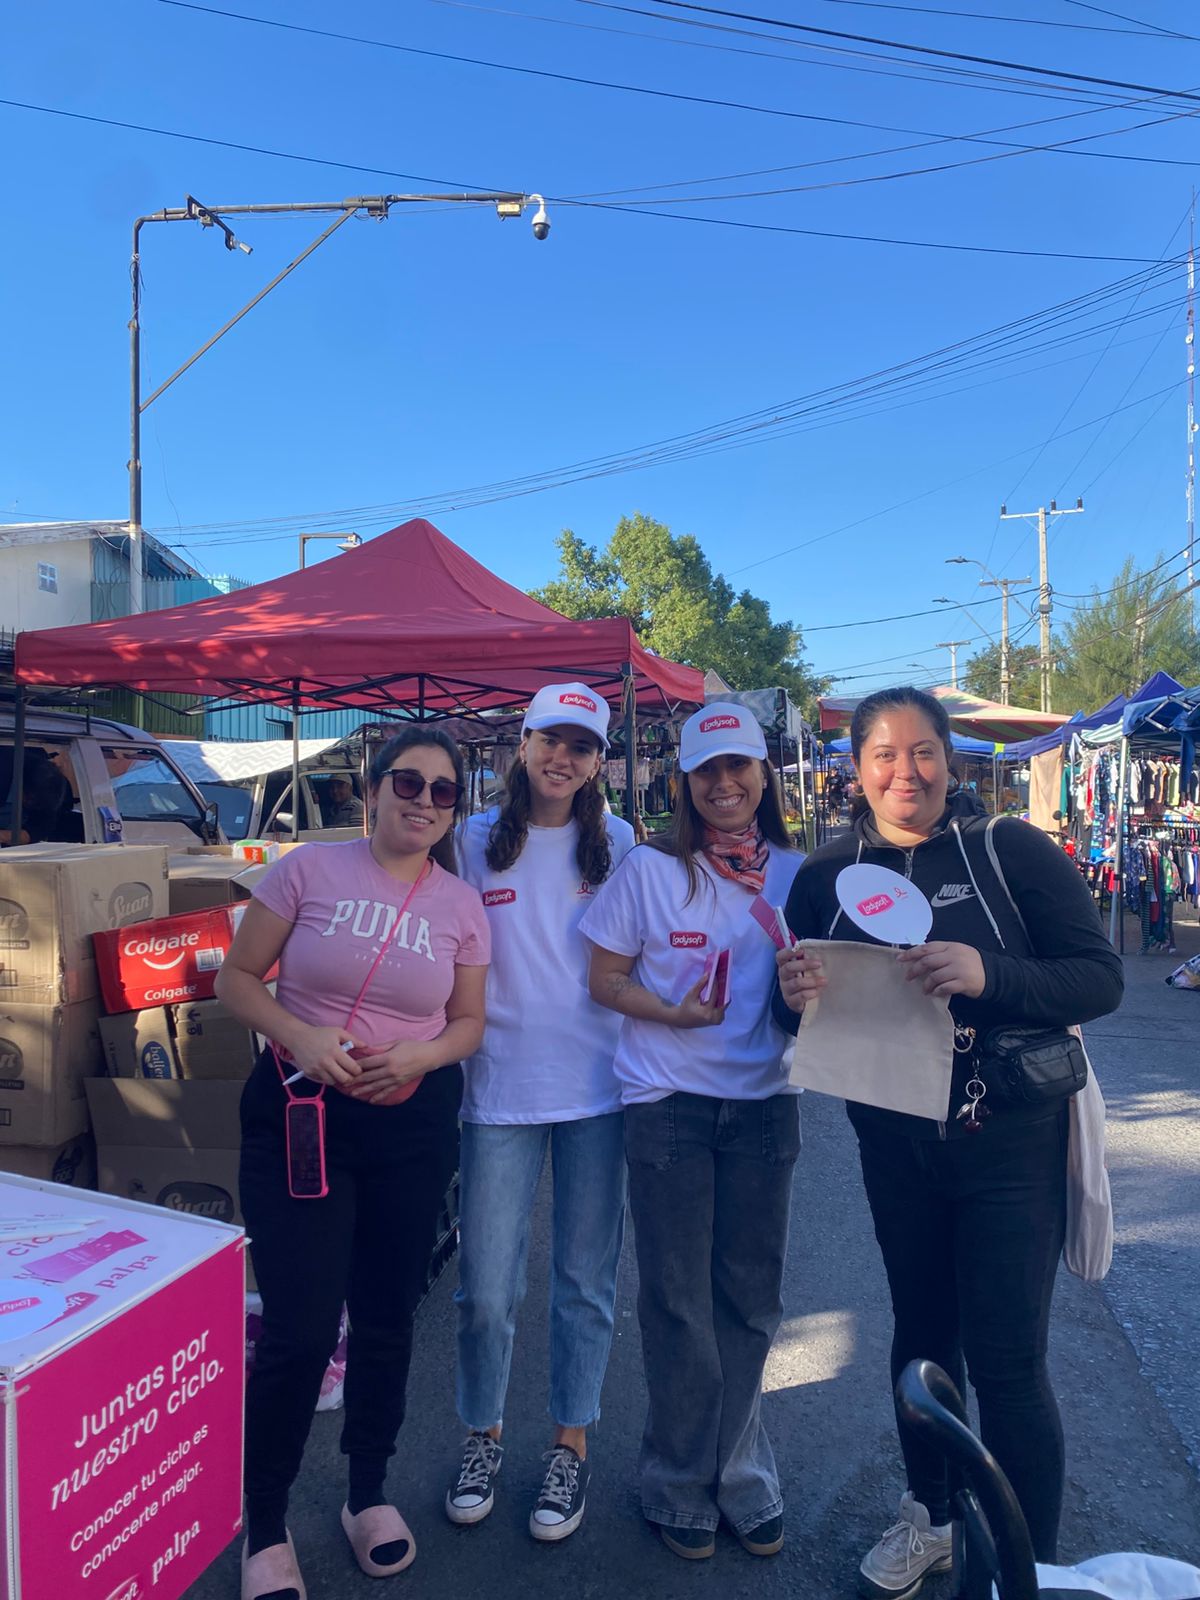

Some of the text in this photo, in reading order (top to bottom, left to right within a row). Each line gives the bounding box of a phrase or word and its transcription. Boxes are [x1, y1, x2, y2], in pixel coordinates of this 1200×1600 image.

[938, 884, 972, 897] NIKE
[123, 931, 200, 957] Colgate
[321, 899, 436, 962] PUMA
[144, 984, 197, 1001] Colgate
[95, 1255, 159, 1289] palpa
[74, 1329, 209, 1449] Juntas por
[52, 1360, 224, 1511] nuestro ciclo.
[70, 1424, 208, 1552] Conocer tu ciclo es
[81, 1461, 204, 1578] conocerte mejor.
[152, 1520, 200, 1586] palpa
